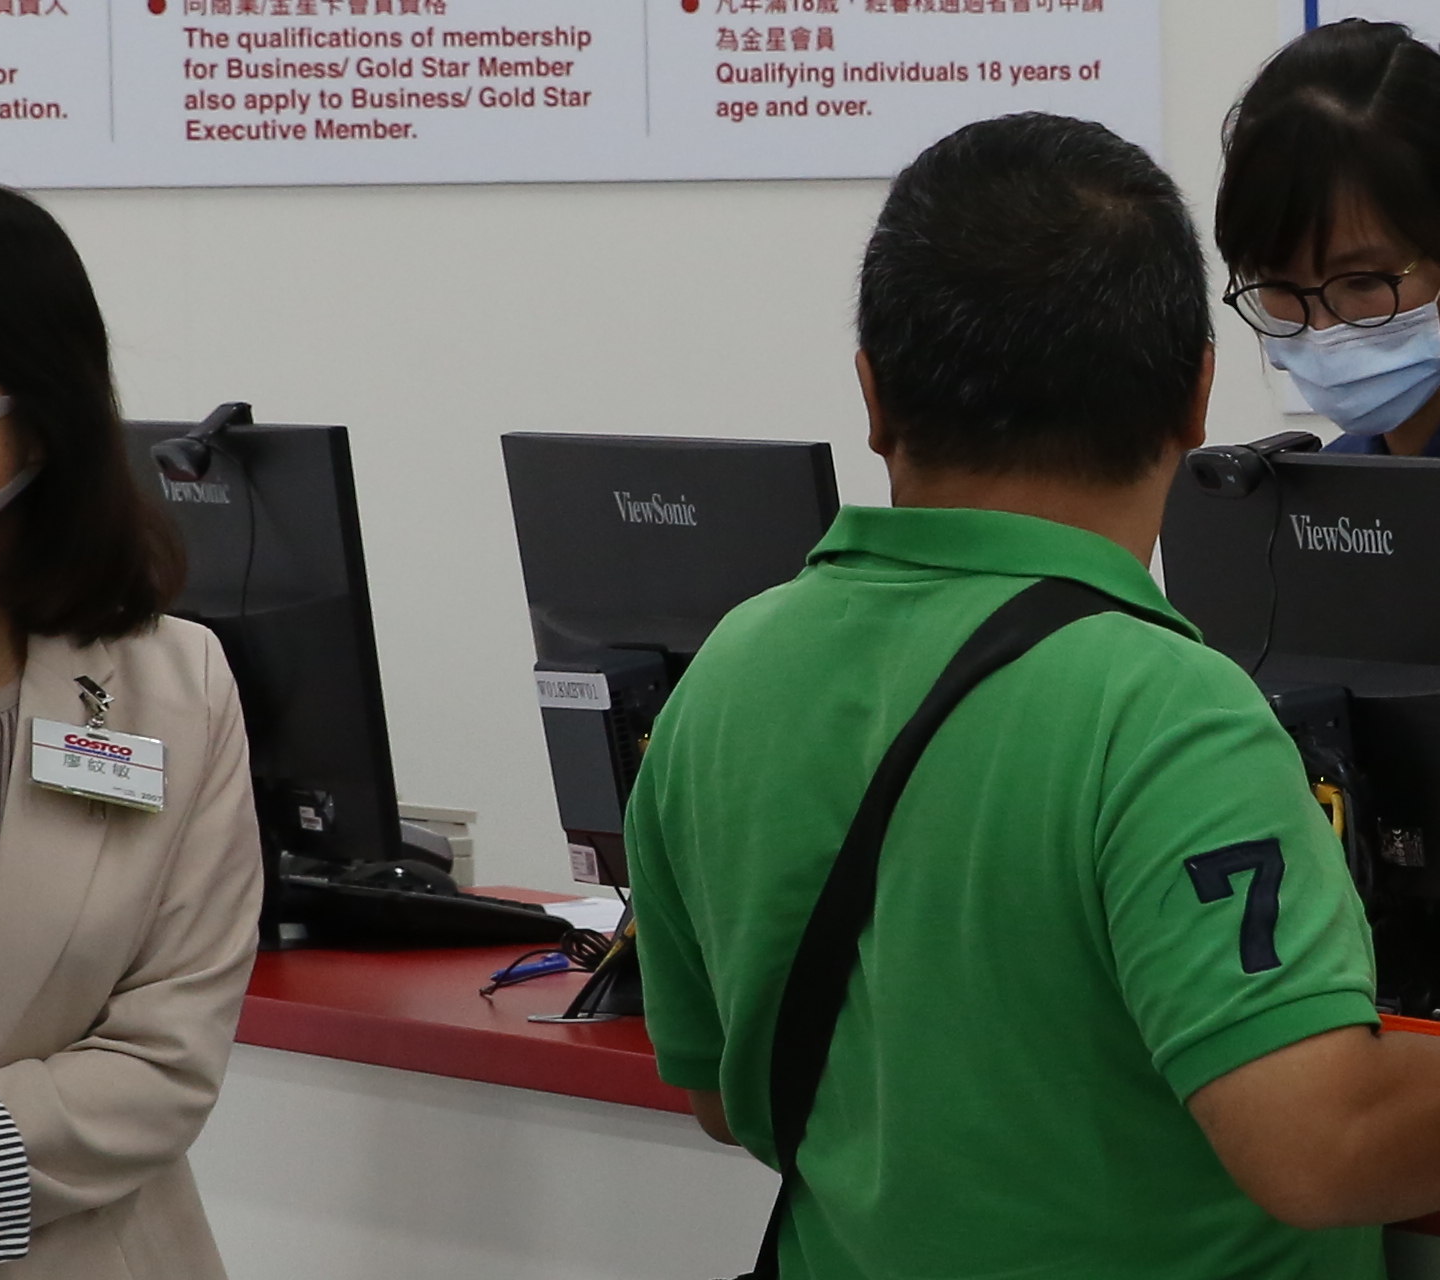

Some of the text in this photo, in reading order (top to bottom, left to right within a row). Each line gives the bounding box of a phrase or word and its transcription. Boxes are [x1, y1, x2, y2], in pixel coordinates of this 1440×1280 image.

[182, 25, 592, 54] The qualifications of membership
[715, 59, 1101, 89] Qualifying individuals 18 years of
[716, 95, 872, 123] age and over.
[614, 490, 698, 527] ViewSonic
[1288, 513, 1395, 556] ViewSonic
[63, 733, 133, 757] COSTCO
[1182, 836, 1286, 976] 7
